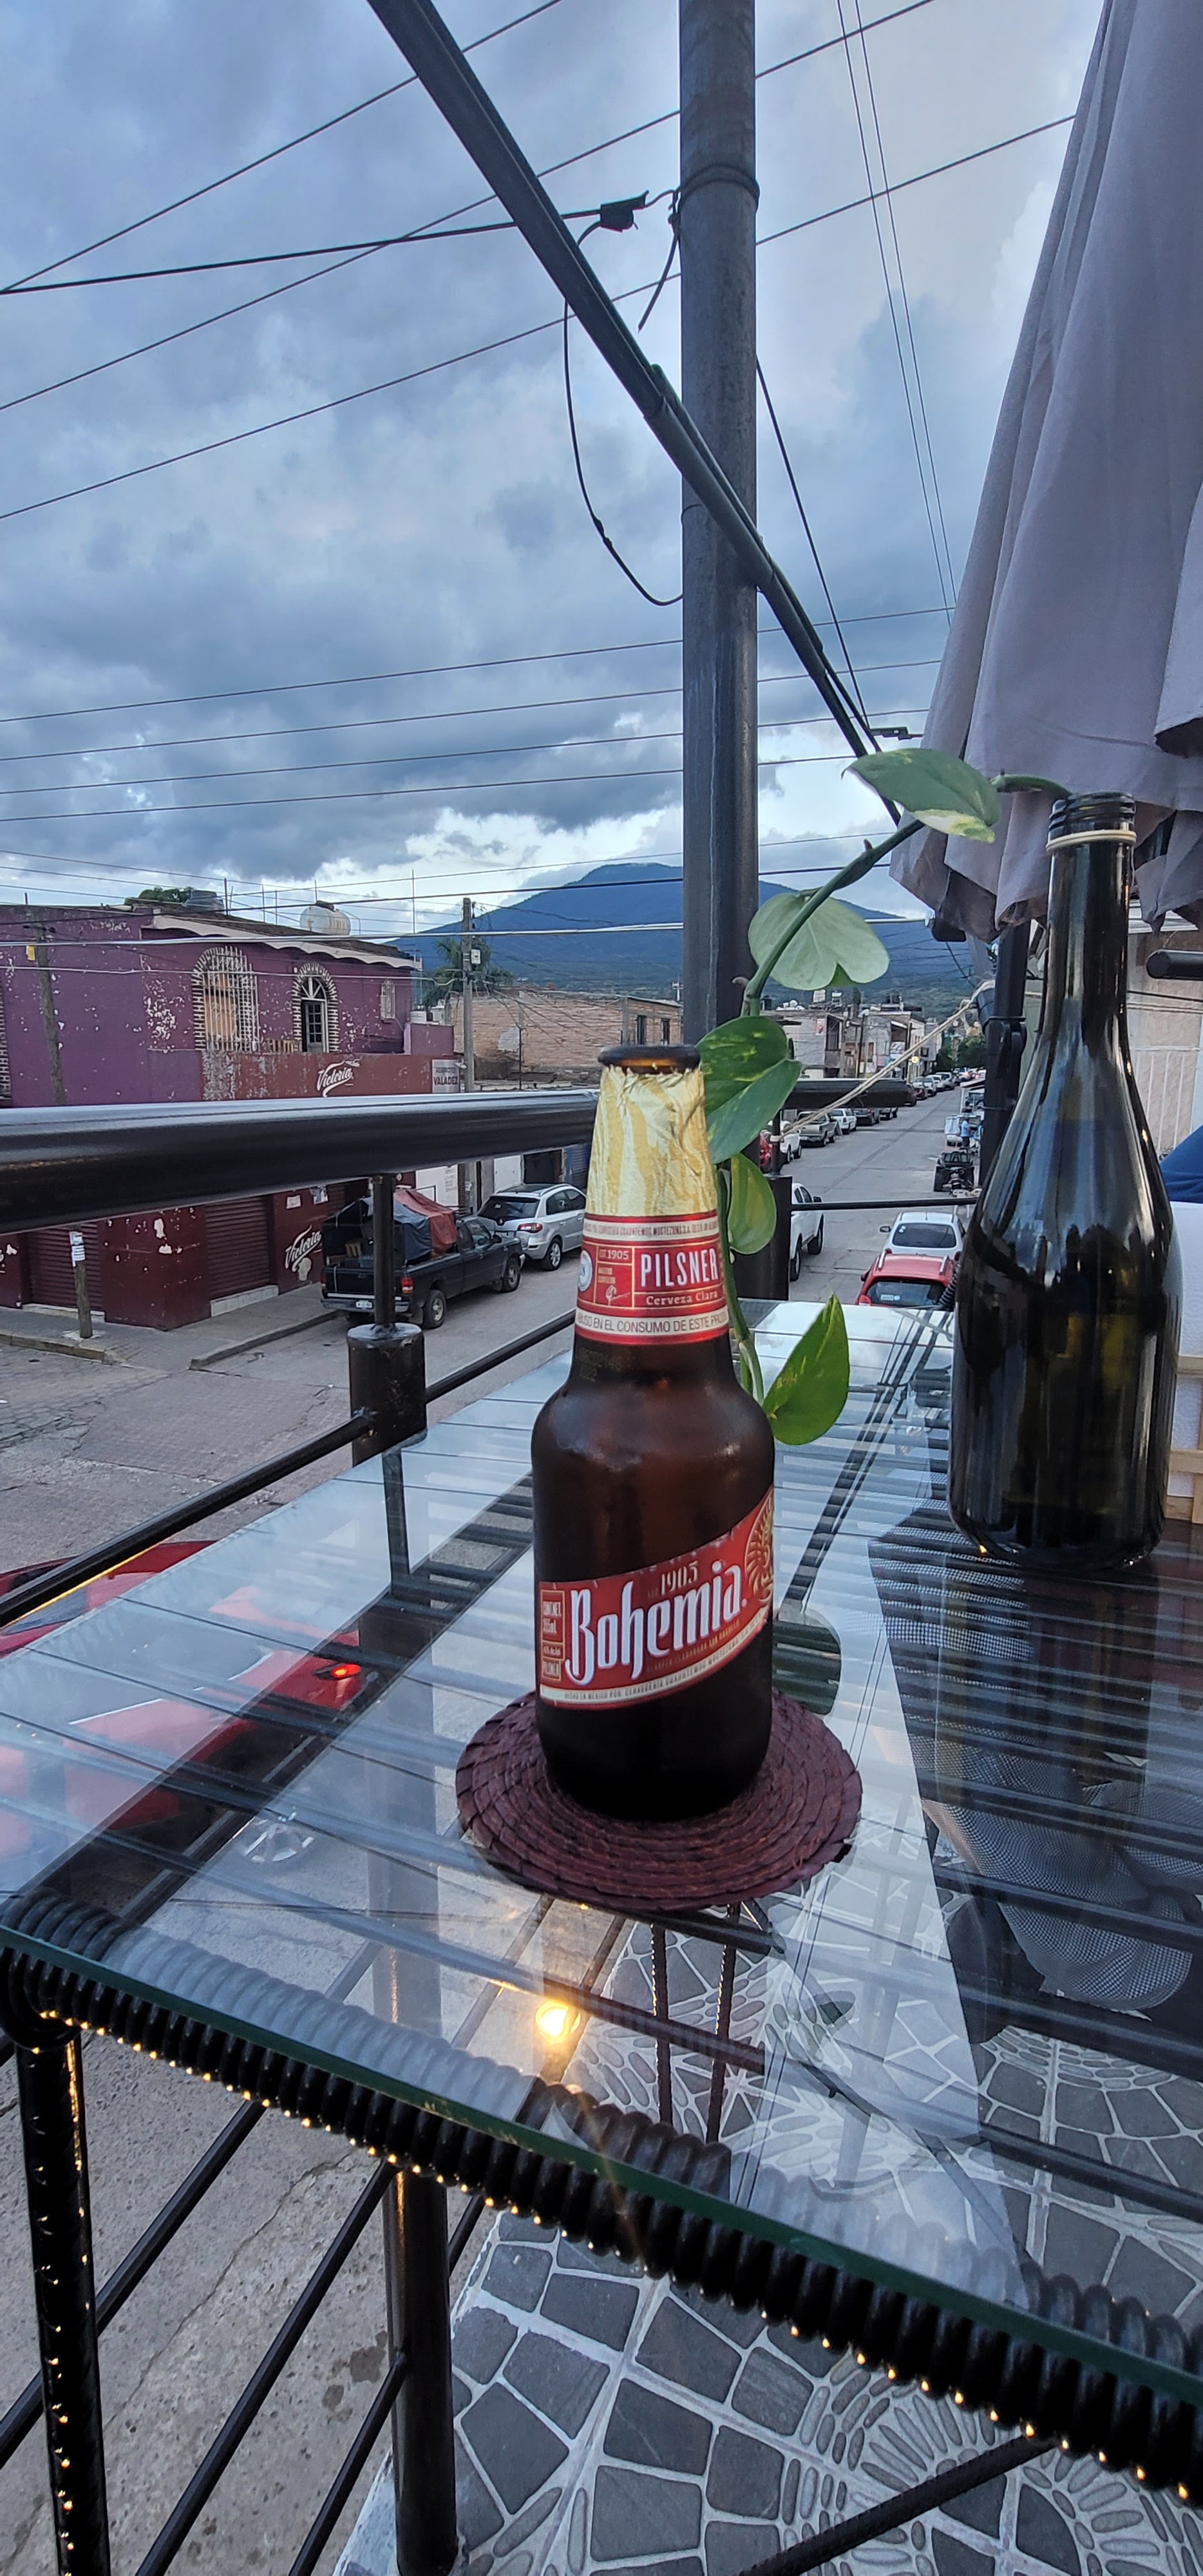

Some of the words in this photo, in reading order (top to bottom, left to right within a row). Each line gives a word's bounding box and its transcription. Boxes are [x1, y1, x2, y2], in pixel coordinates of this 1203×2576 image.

[317, 1061, 354, 1097] Victoria
[433, 1076, 458, 1085] VALADEZ
[285, 1226, 321, 1272] Victoria
[607, 1250, 629, 1260] 1905
[641, 1248, 719, 1287] PILSNER
[646, 1295, 692, 1305] Cerveza
[696, 1291, 718, 1301] Clara
[594, 1317, 603, 1329] EN
[605, 1319, 614, 1331] EL
[617, 1320, 670, 1333] CONSUMO
[673, 1320, 687, 1331] DE
[688, 1316, 710, 1330] ESTE
[661, 1561, 698, 1596] 1905
[565, 1560, 741, 1686] Bohemia
